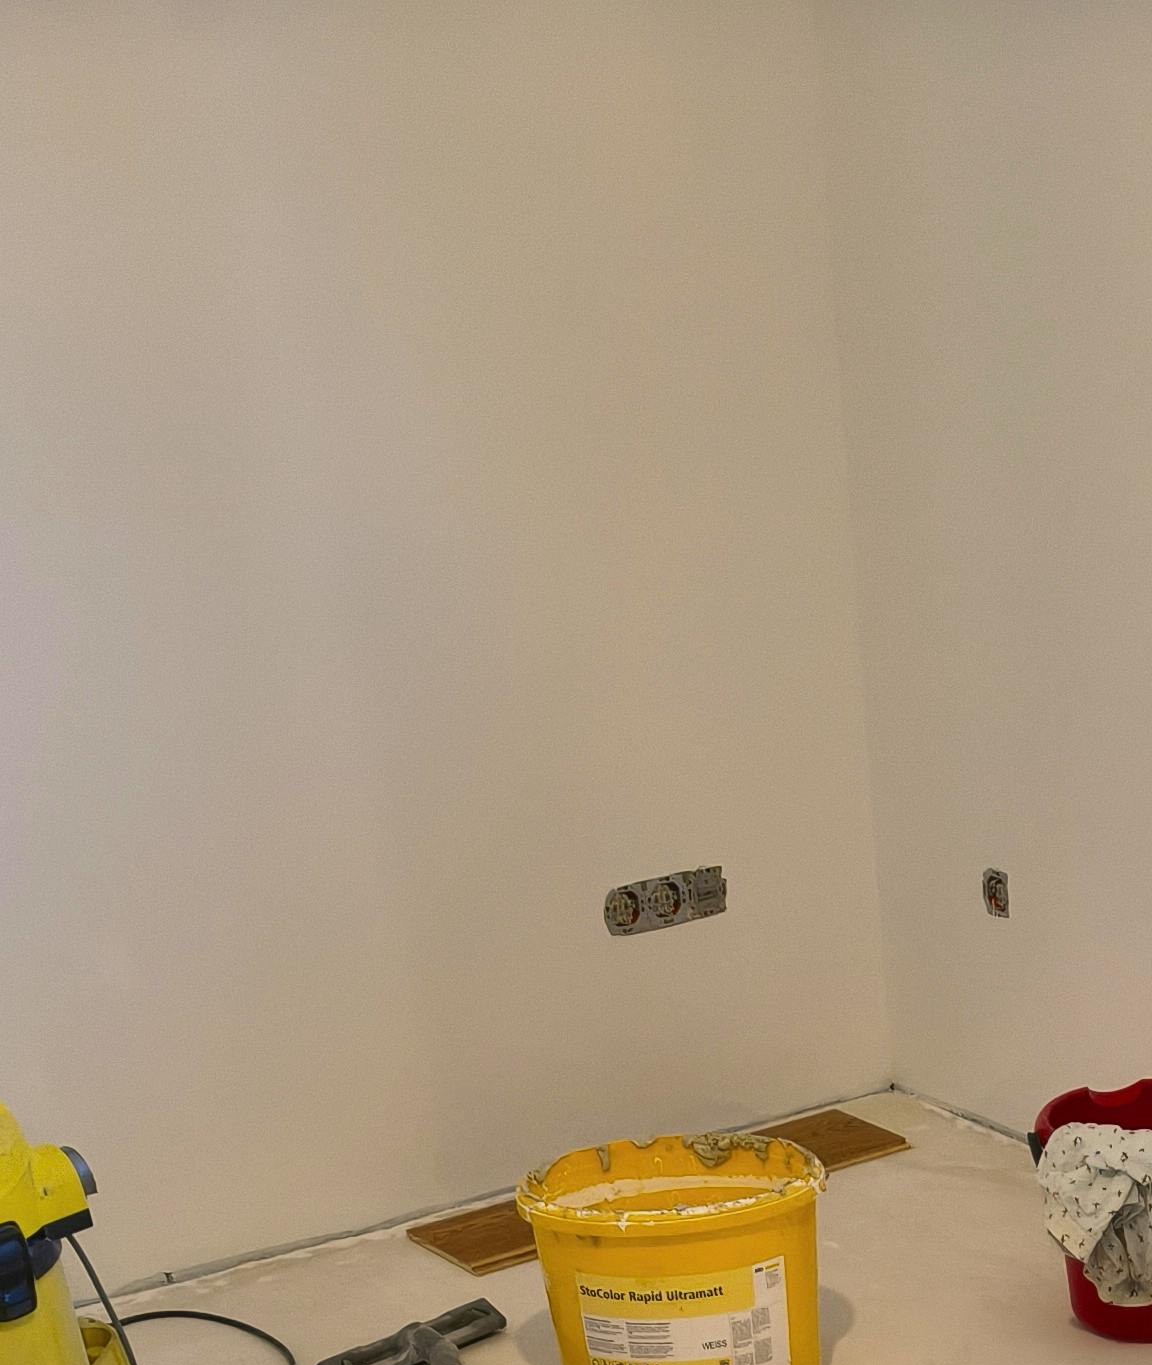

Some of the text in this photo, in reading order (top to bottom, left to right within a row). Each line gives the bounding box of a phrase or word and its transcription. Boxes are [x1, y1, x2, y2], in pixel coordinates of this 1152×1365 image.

[579, 1285, 724, 1304] StoColor Rapid Ultramatt
[702, 1340, 728, 1350] WEISS
